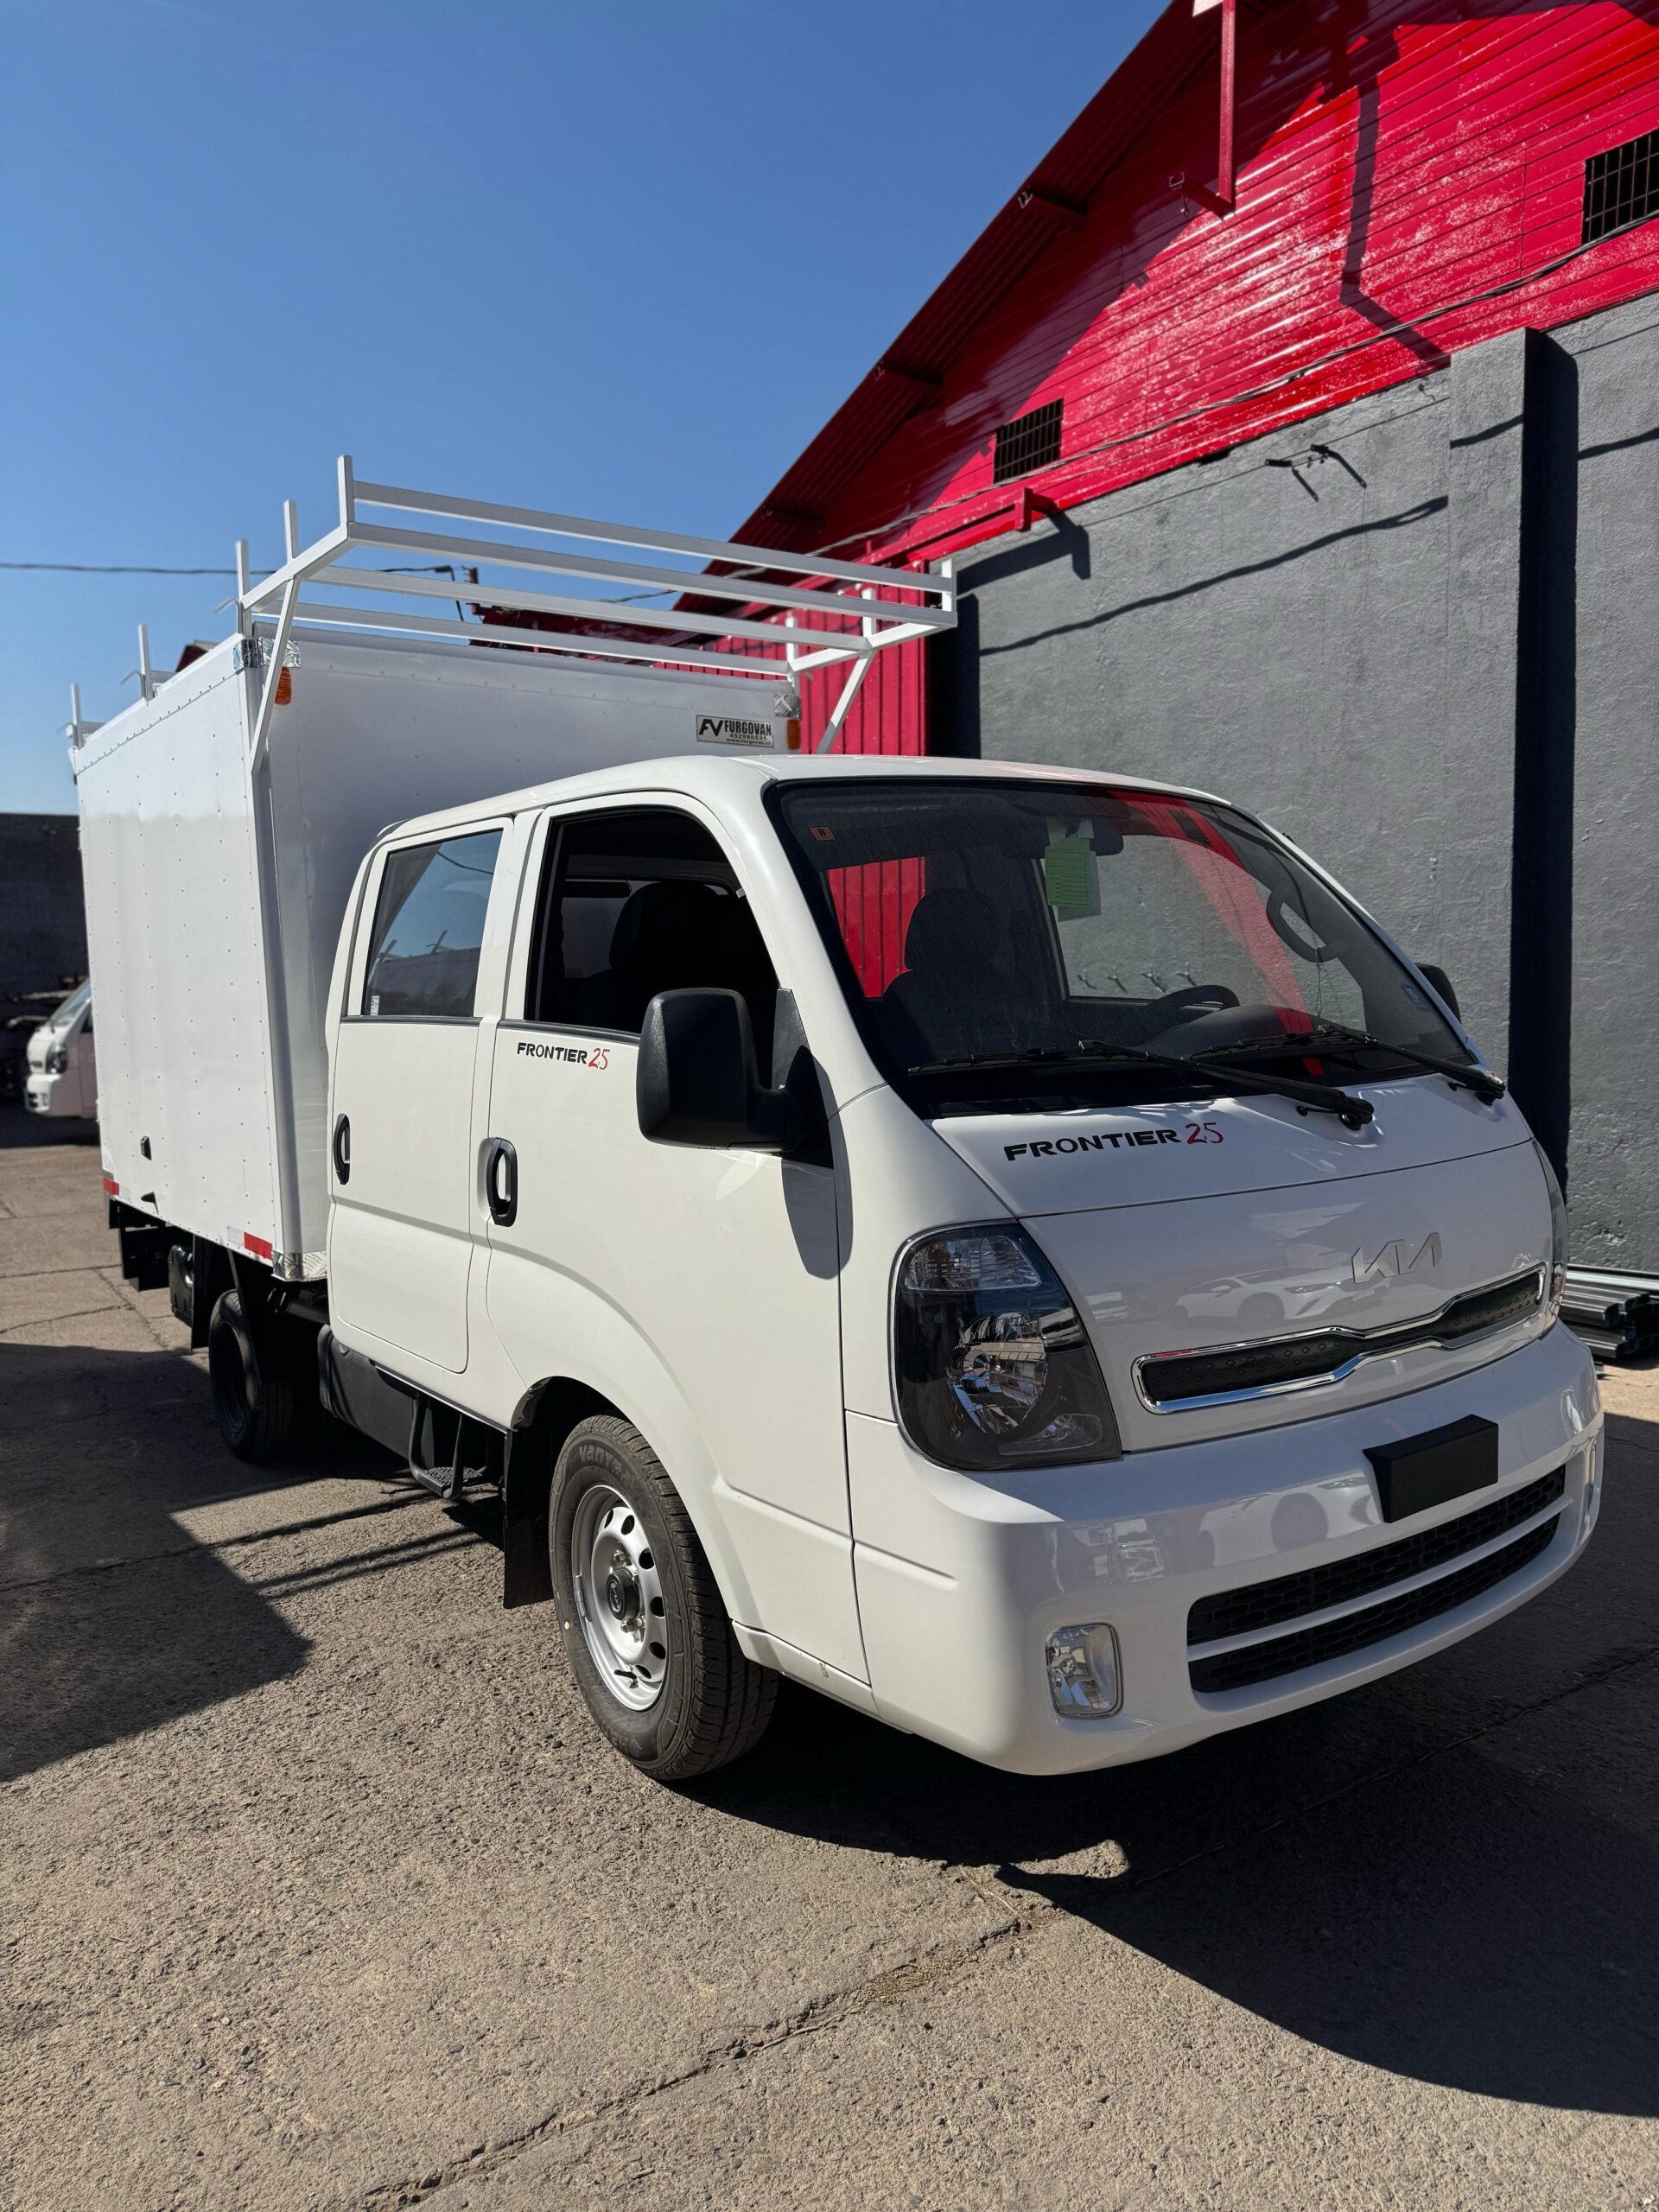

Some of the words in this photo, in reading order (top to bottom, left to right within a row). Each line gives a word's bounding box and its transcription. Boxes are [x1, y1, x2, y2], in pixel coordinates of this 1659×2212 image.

[724, 720, 772, 736] FURGOVAN
[517, 1042, 588, 1064] FRONTIER
[1003, 1128, 1182, 1161] FRONTIER
[1351, 1232, 1443, 1285] KIA
